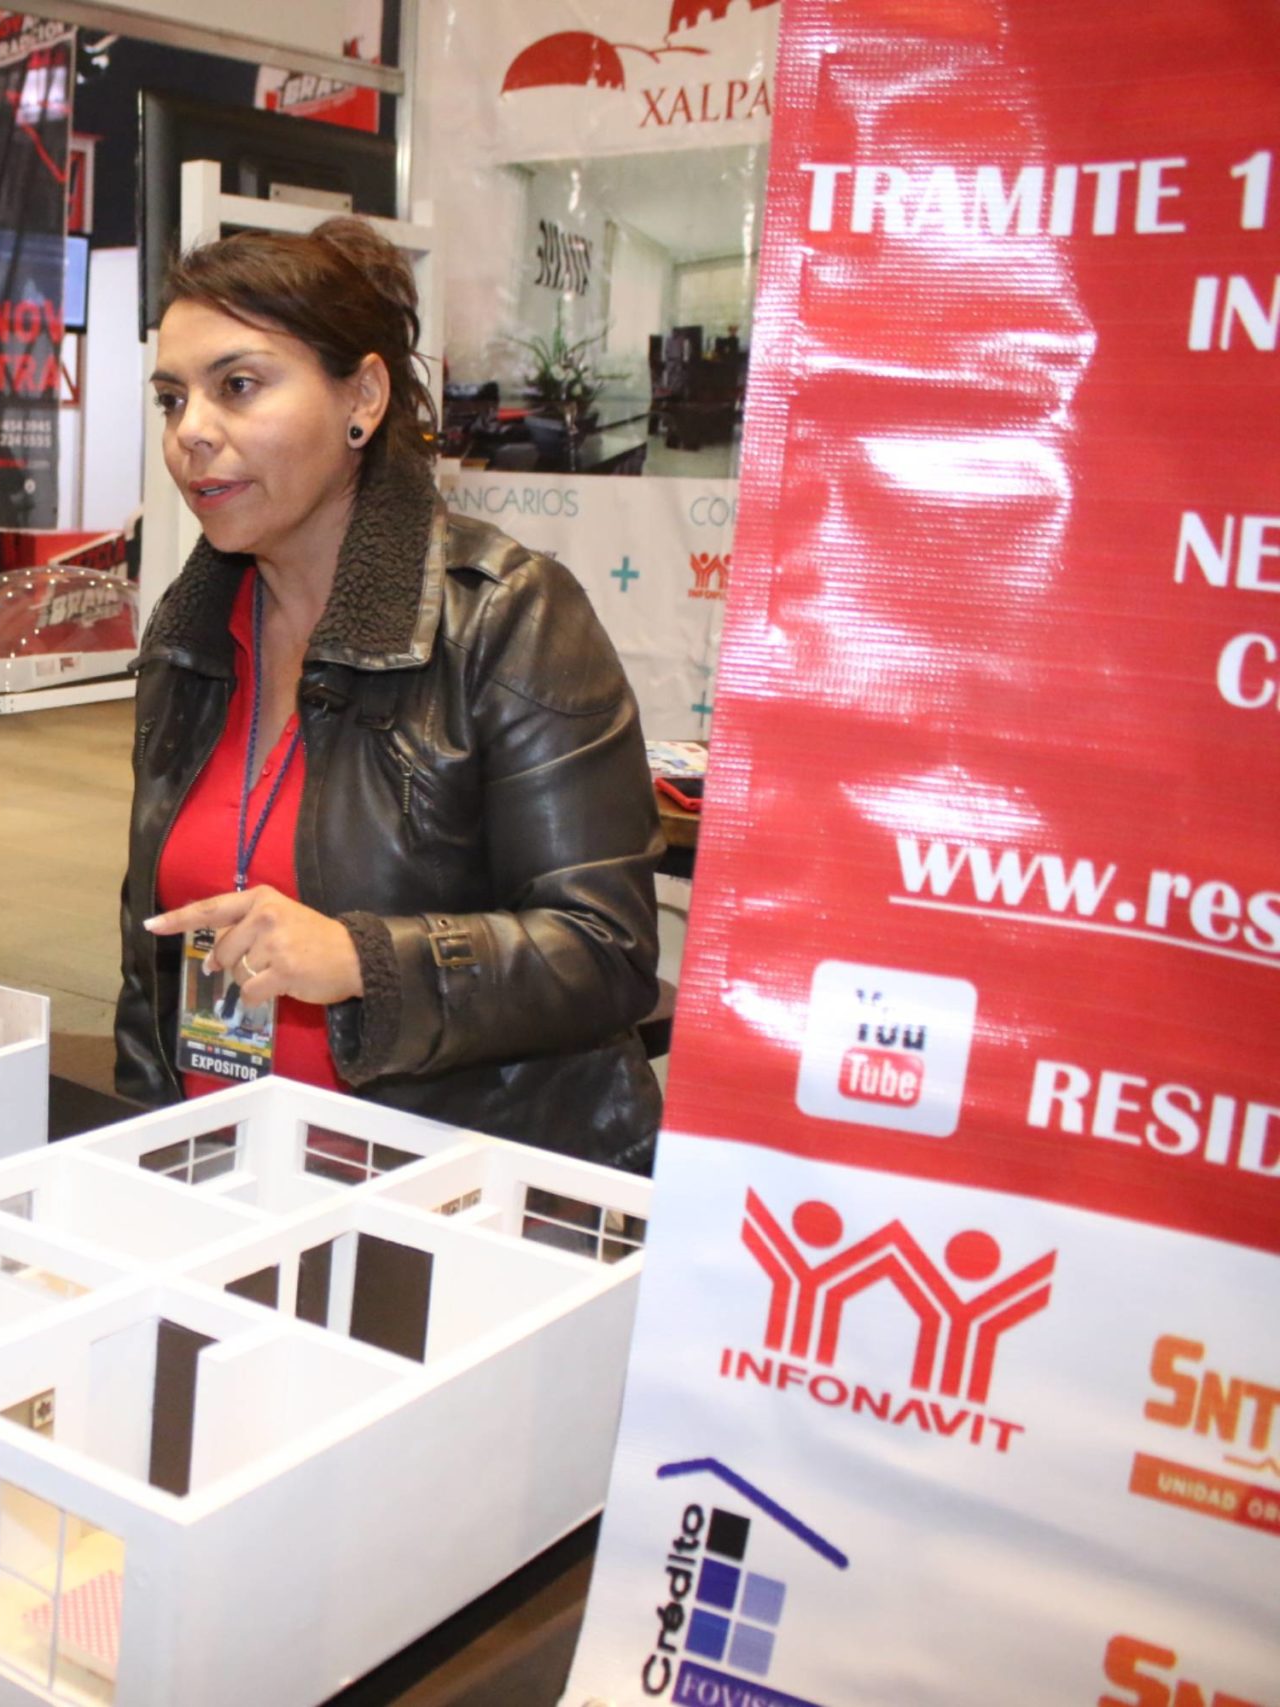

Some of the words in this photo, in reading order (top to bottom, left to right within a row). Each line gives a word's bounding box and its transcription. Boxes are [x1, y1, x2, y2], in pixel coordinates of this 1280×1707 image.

[639, 78, 771, 128] XALPA
[800, 157, 1187, 236] TRAMITE
[1230, 151, 1272, 230] 1
[444, 486, 580, 517] ANCARIOS
[689, 497, 738, 527] CO
[191, 1053, 258, 1081] EXPOSITOR
[844, 1053, 917, 1100] Tube
[720, 1348, 1026, 1453] INFONAVIT
[1157, 1472, 1238, 1512] UNIDAD
